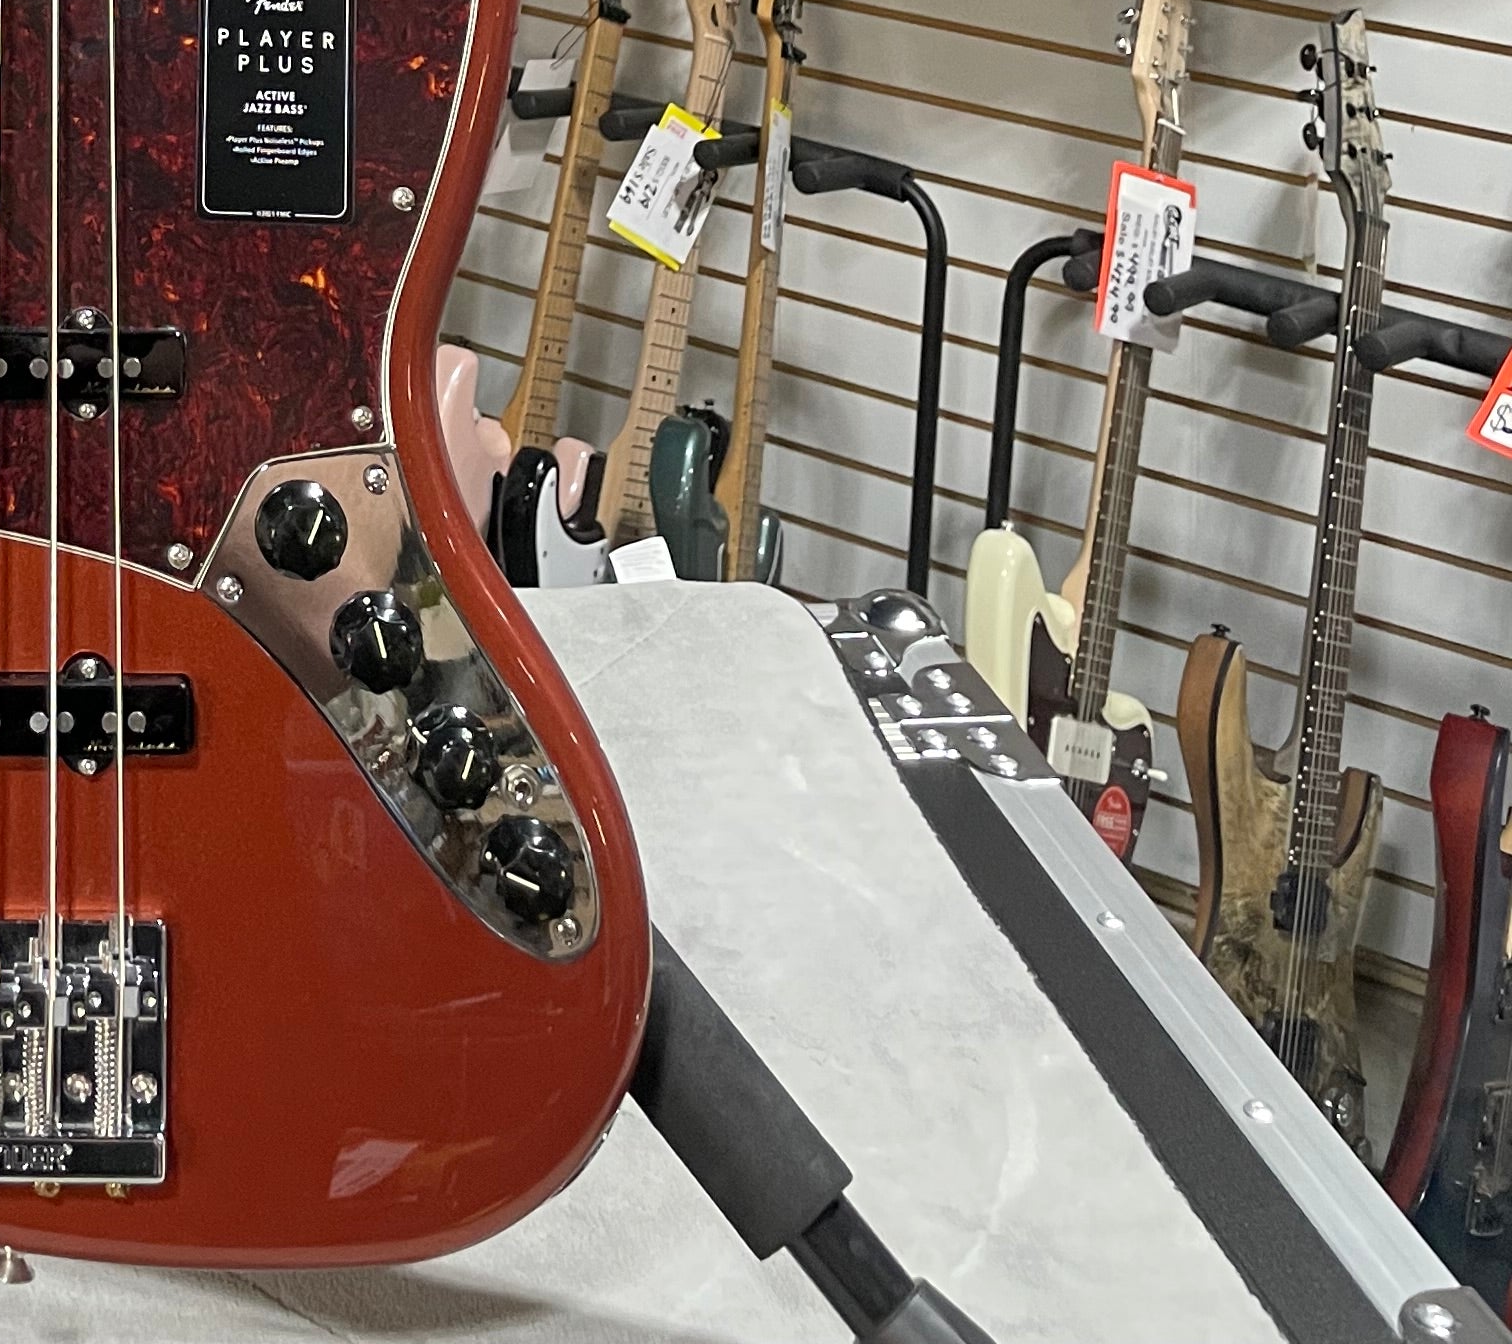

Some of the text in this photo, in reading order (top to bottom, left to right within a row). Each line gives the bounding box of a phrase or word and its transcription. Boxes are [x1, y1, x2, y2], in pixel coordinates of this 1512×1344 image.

[216, 26, 337, 51] PLAYER
[237, 53, 315, 75] PLUS
[255, 90, 296, 102] ACTIVE
[243, 102, 273, 114] JAZZ
[1118, 212, 1131, 245] Sale
